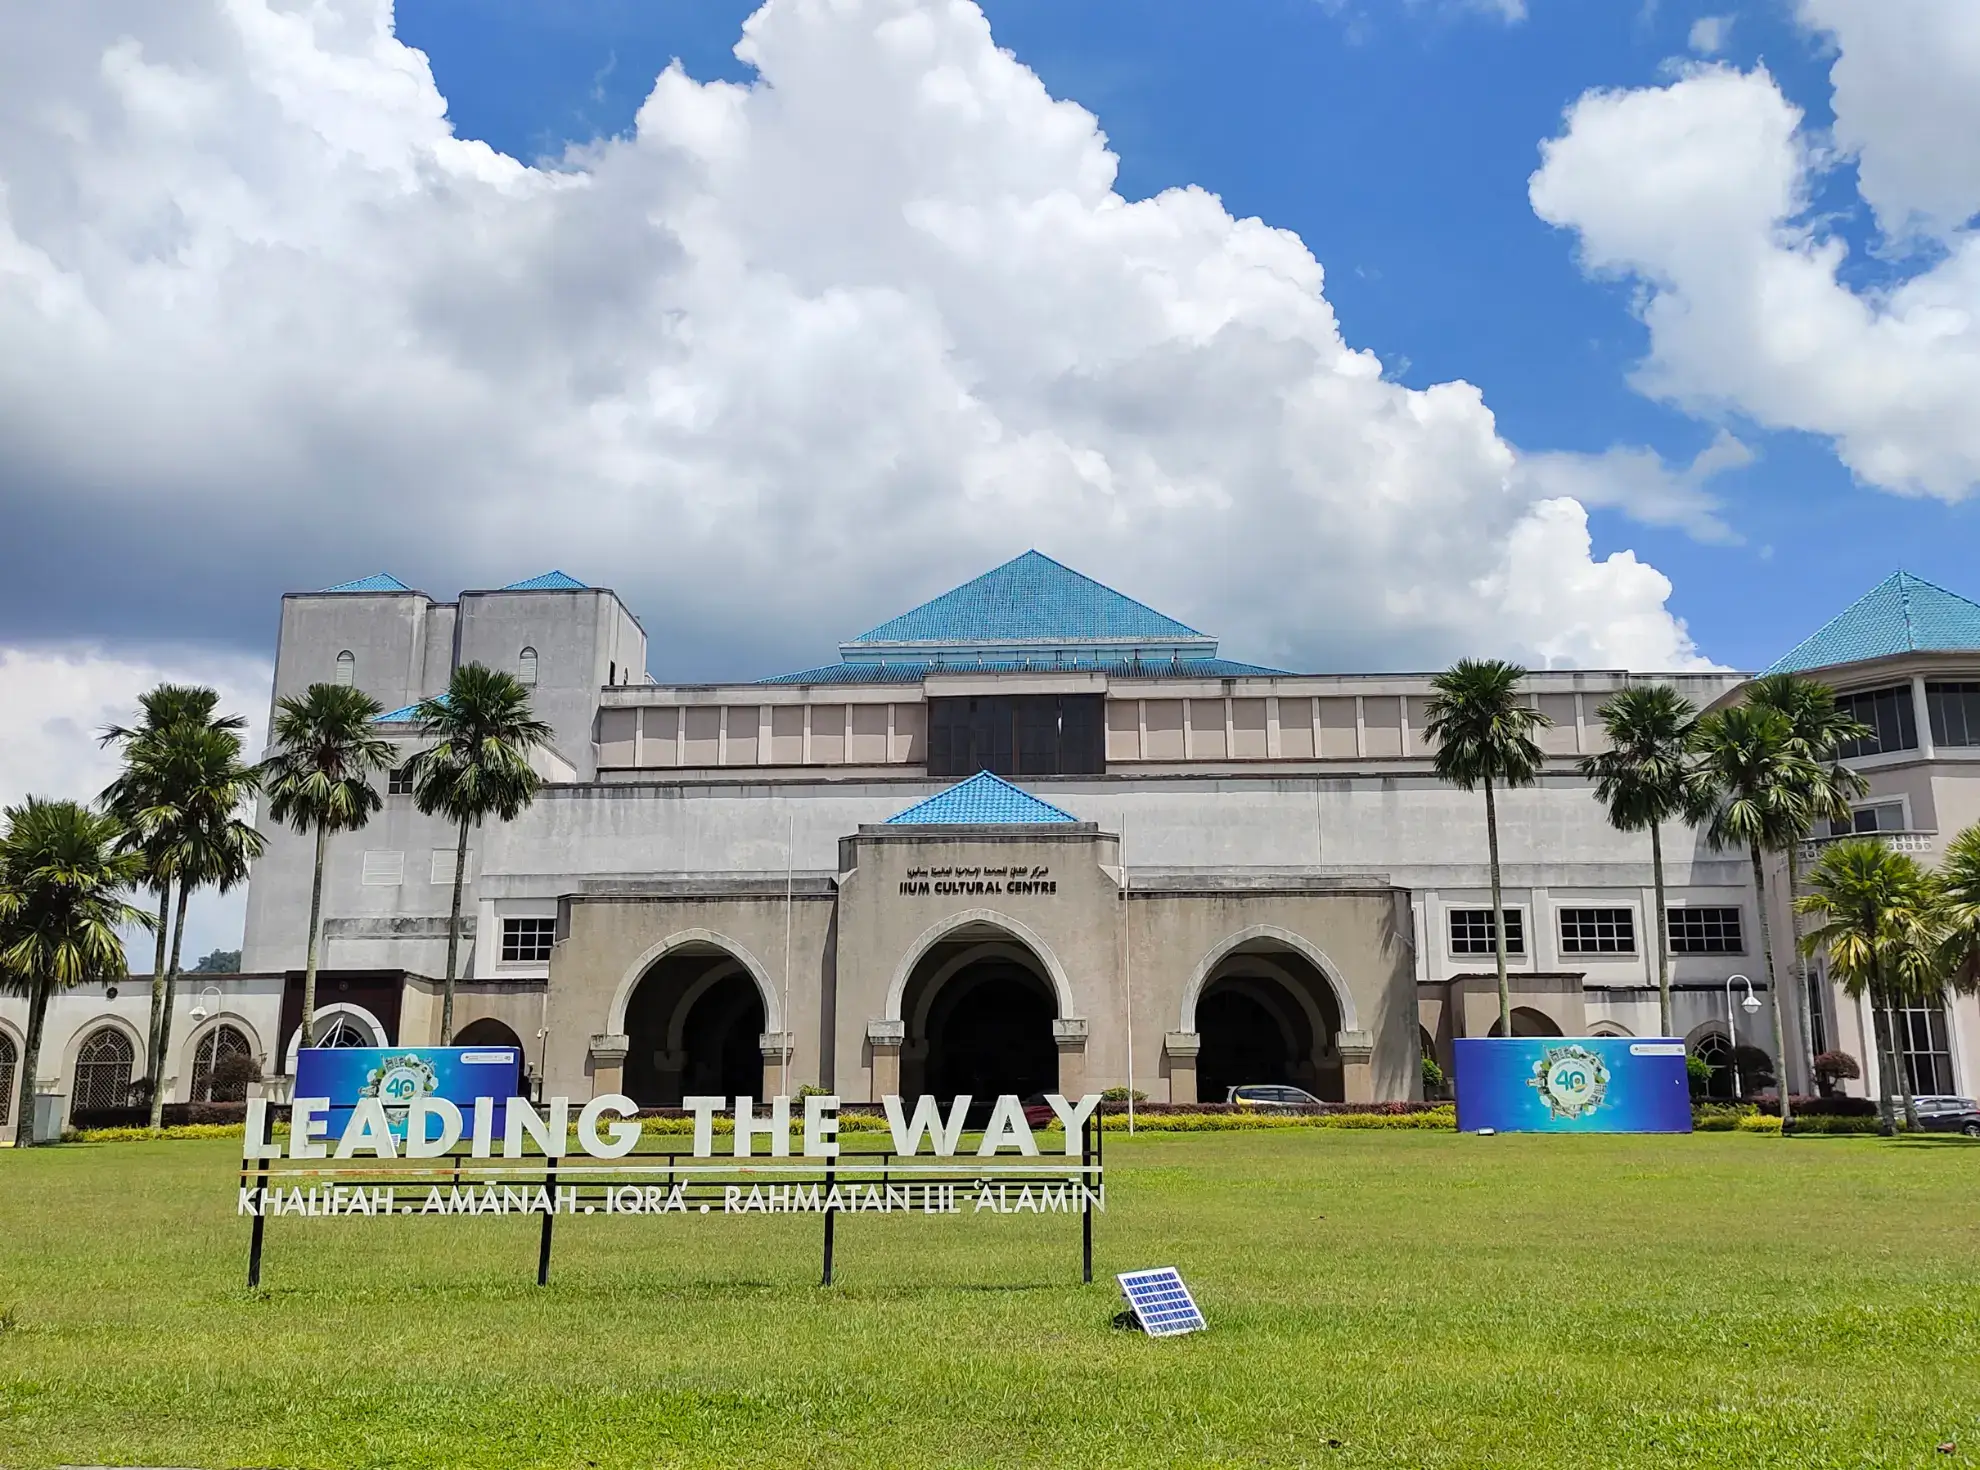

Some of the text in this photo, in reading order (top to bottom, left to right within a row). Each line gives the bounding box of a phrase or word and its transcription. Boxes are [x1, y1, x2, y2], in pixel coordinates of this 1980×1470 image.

[899, 881, 1057, 896] IIUM CULTURAL CENTRE
[243, 1094, 1104, 1160] LEADING THE WAY
